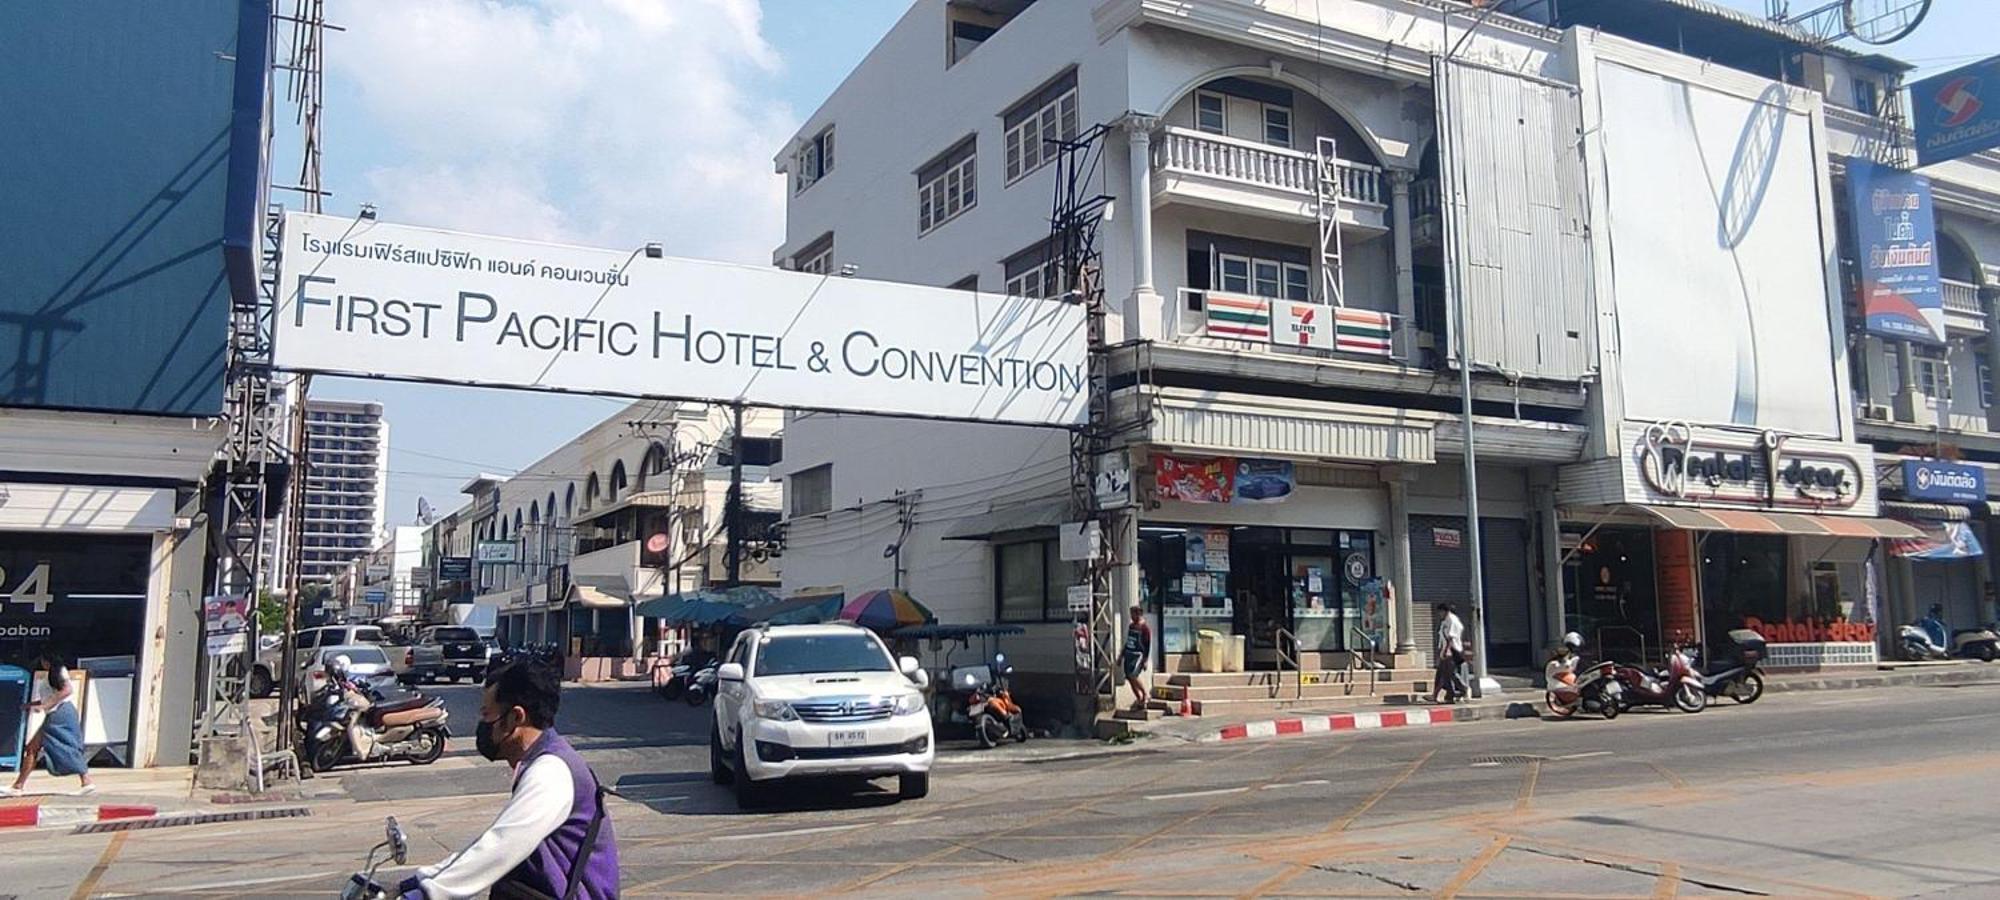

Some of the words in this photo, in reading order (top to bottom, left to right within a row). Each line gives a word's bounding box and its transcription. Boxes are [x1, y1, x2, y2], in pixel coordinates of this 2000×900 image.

[301, 231, 482, 272] โรงแรมเฟิร์สแปซิฟิก
[488, 254, 536, 279] แอนด์
[541, 262, 630, 288] คอนเวนชั่น
[294, 274, 442, 339] FIRST
[456, 291, 638, 356] PACIFIC
[653, 311, 797, 371] HOTEL
[806, 340, 832, 375] &
[841, 330, 1082, 394] CONVENTION
[1291, 306, 1315, 346] 7
[0, 563, 54, 613] 4
